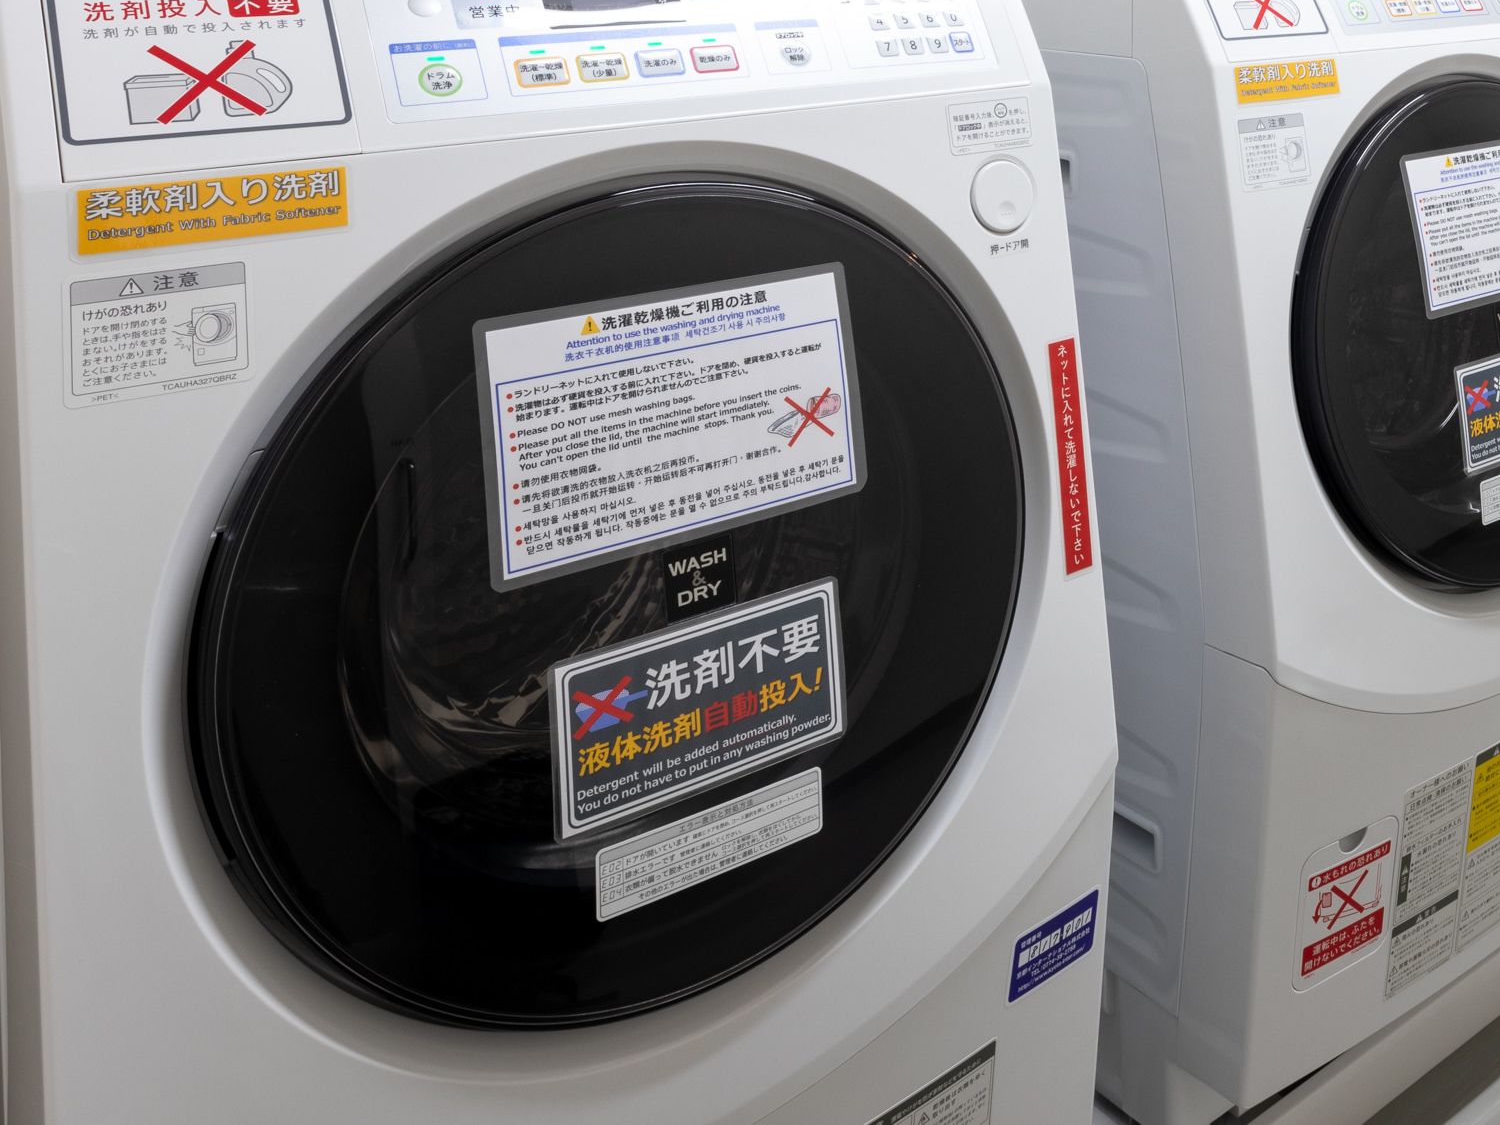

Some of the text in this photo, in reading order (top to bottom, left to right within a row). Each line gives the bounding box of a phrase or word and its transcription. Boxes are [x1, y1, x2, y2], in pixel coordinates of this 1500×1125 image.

[82, 18, 307, 40] 洗剤が自動で投入されます
[910, 40, 917, 50] 8
[934, 39, 941, 48] 9
[1239, 61, 1334, 84] 柔軟剤入り洗剤
[85, 171, 340, 221] 柔軟剤入り洗剤
[88, 205, 341, 240] Detergent With Fabric Softener
[154, 272, 200, 291] 注意
[82, 301, 168, 321] けがの恐れあり
[566, 303, 780, 349] Attention to use the washing and drying machine
[601, 289, 767, 331] 洗濯乾燥機ご利用の注意
[517, 393, 695, 438] Please DO NOT use mesh washing bags.
[1057, 345, 1084, 566] ネットに入れて洗濯しないで下さい
[668, 548, 727, 576] WASH
[677, 580, 722, 607] DRY
[645, 614, 822, 710] 洗剤不要
[577, 711, 797, 803] Detergent will be added automatically.
[577, 711, 831, 815] You do not have to put in any washing powder.
